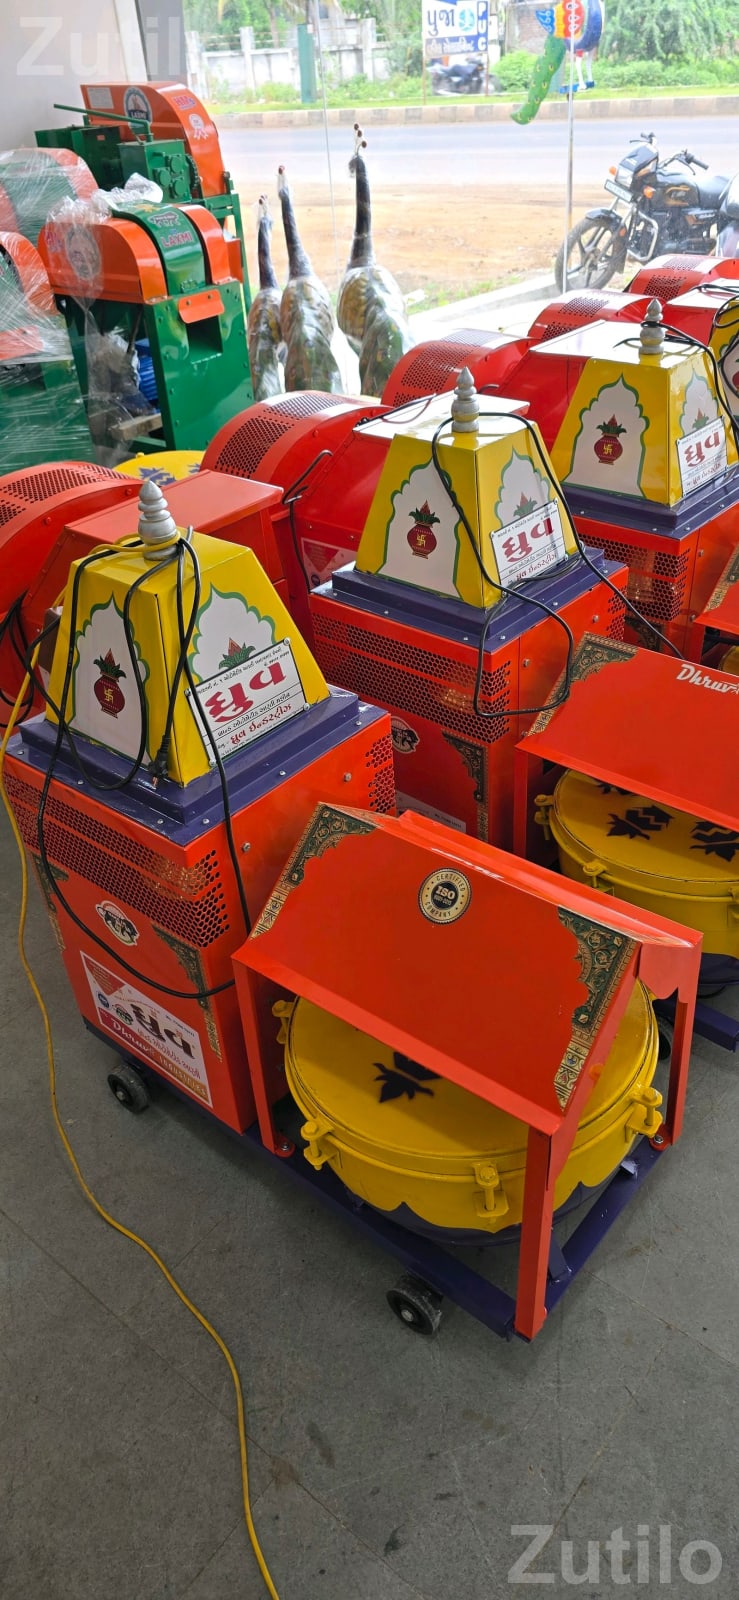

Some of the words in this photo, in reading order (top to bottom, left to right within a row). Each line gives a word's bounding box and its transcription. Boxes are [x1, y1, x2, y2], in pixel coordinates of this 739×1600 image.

[162, 231, 194, 248] LAXMI
[676, 664, 735, 693] Dhruv
[436, 873, 466, 892] CERTIFIED
[436, 886, 456, 900] ISO
[424, 901, 451, 918] COMPANY
